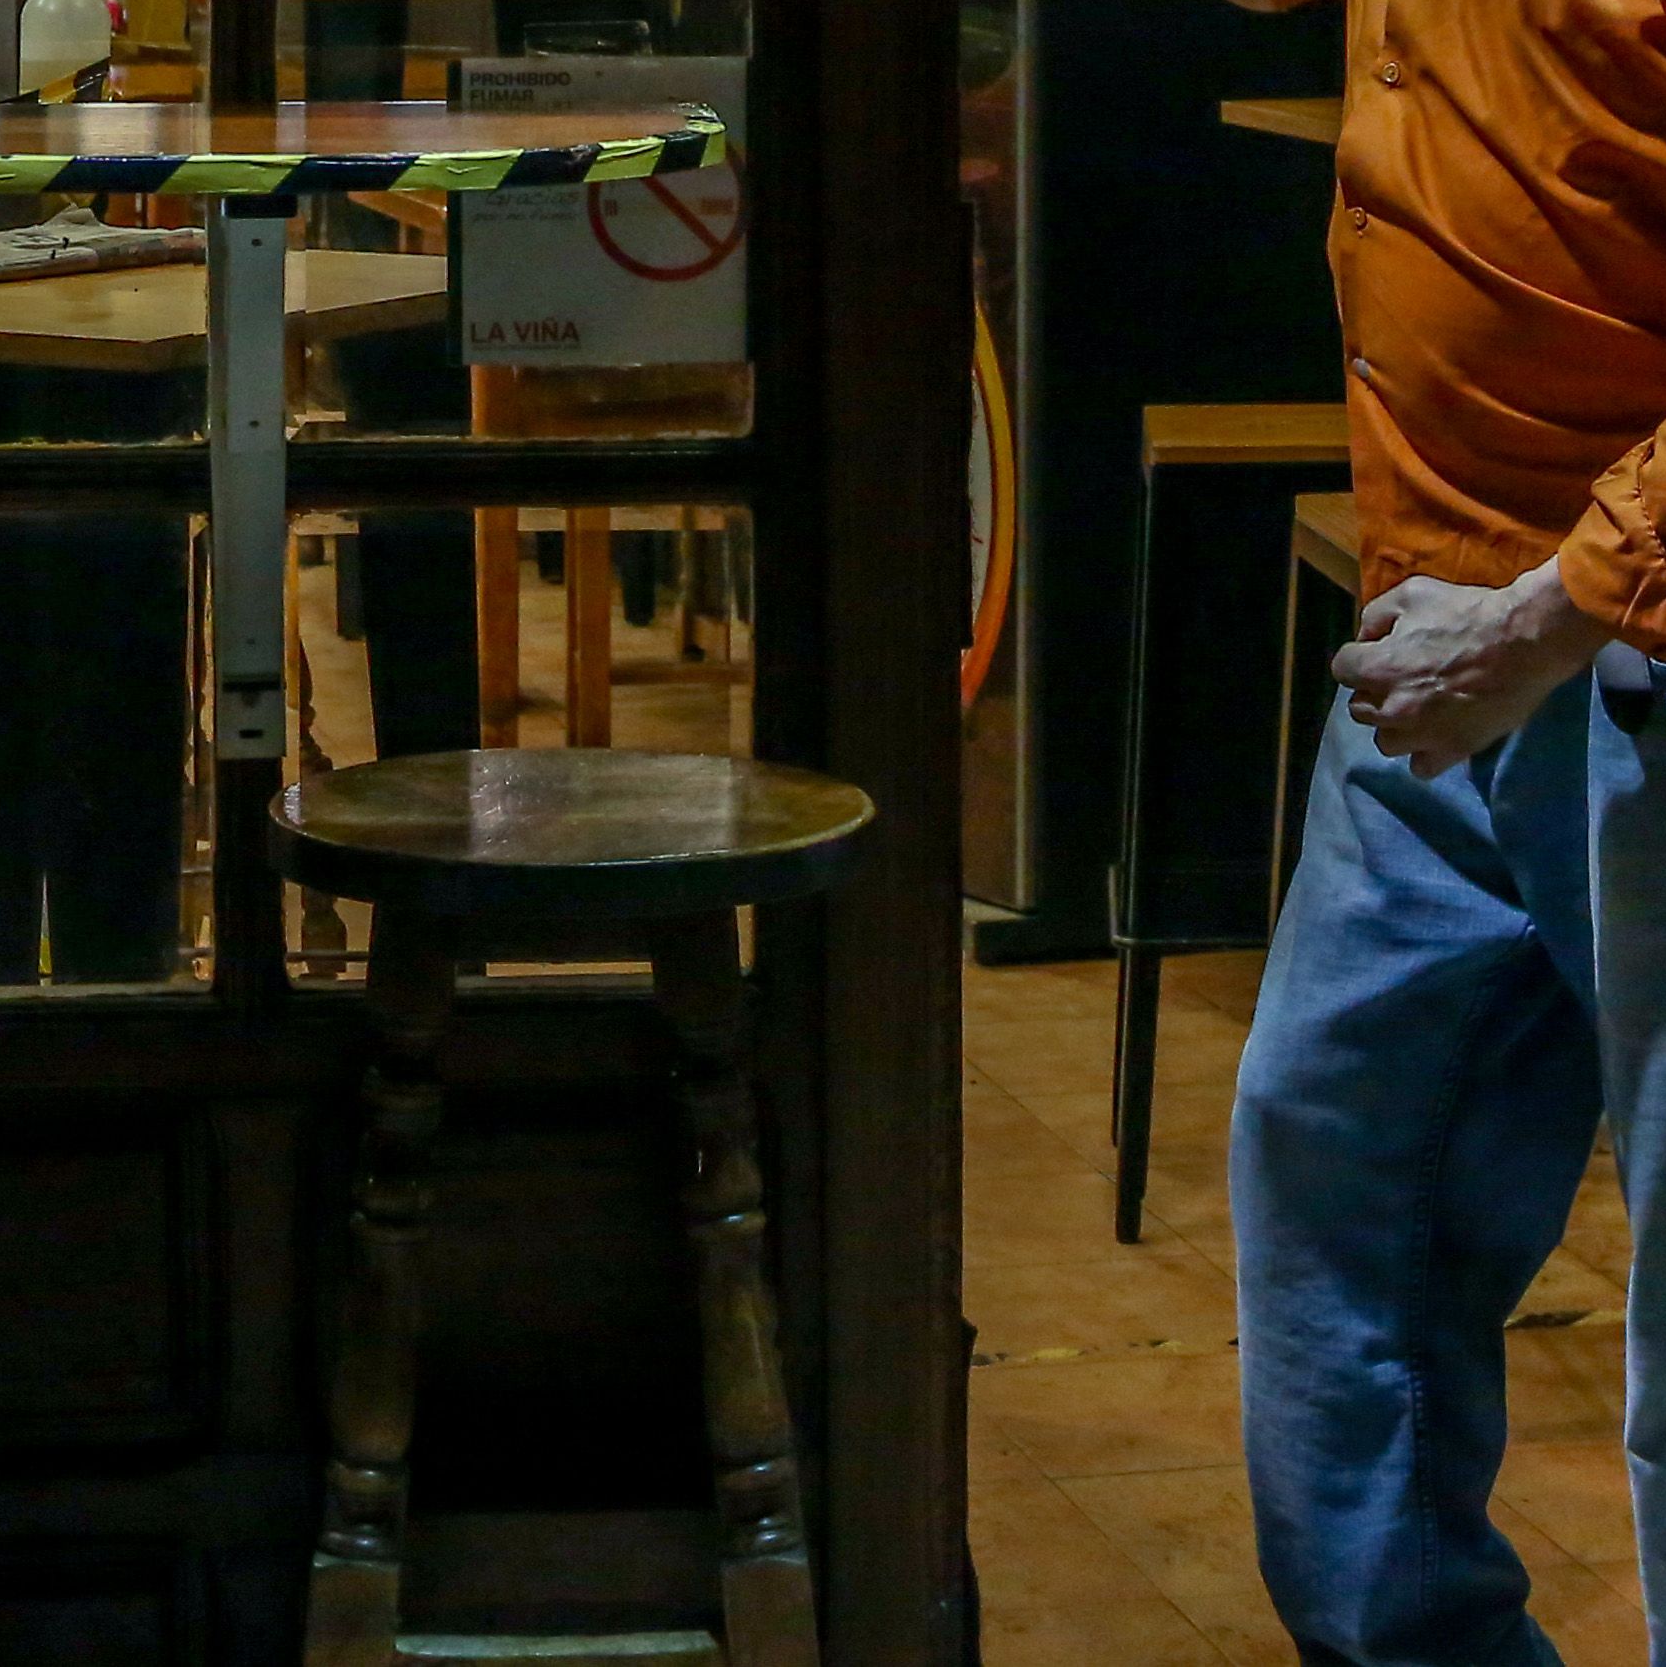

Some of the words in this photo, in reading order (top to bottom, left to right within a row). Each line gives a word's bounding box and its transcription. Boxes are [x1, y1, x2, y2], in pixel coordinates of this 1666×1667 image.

[470, 72, 572, 86] PROHIBIDO
[470, 322, 506, 343] LA
[514, 316, 581, 343] VIÑA
